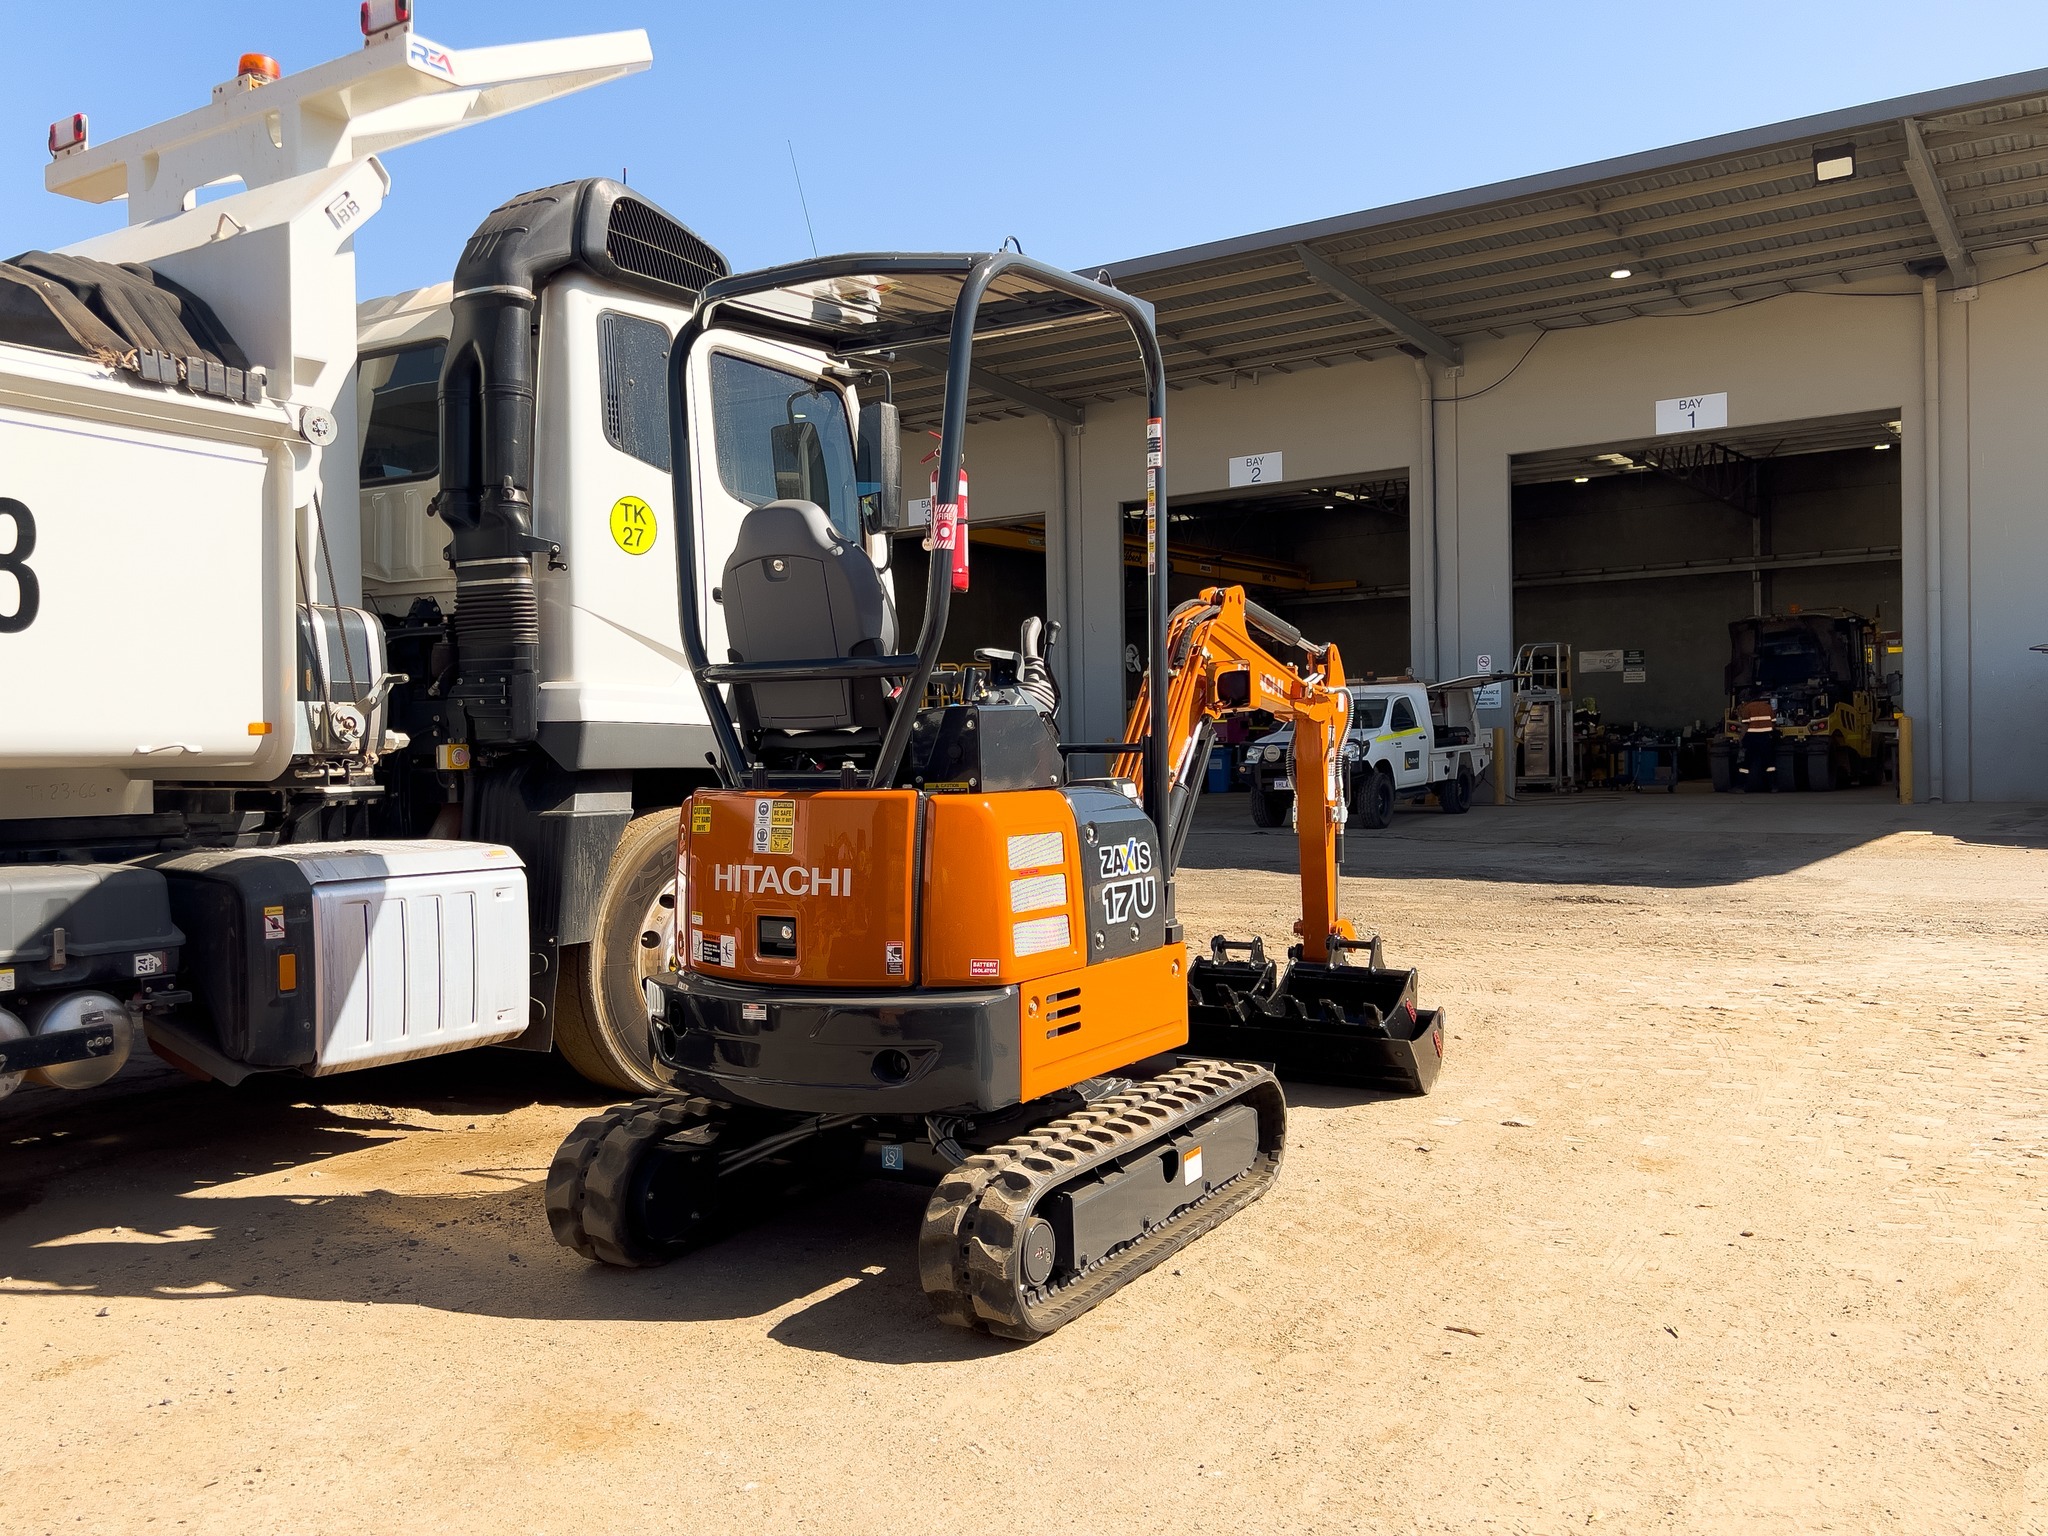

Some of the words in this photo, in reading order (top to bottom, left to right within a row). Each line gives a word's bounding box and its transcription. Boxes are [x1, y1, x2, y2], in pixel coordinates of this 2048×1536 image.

[1678, 397, 1703, 410] BAY
[1687, 410, 1695, 428] 1
[1246, 456, 1265, 467] BAY
[1251, 467, 1261, 483] 2
[921, 500, 931, 508] BA
[620, 502, 646, 525] TK
[938, 512, 953, 520] FIRE
[623, 526, 644, 547] 27
[1099, 837, 1152, 878] ZAXIS
[714, 863, 852, 897] HITACHI
[1102, 876, 1156, 924] 17U
[138, 957, 148, 972] 24
